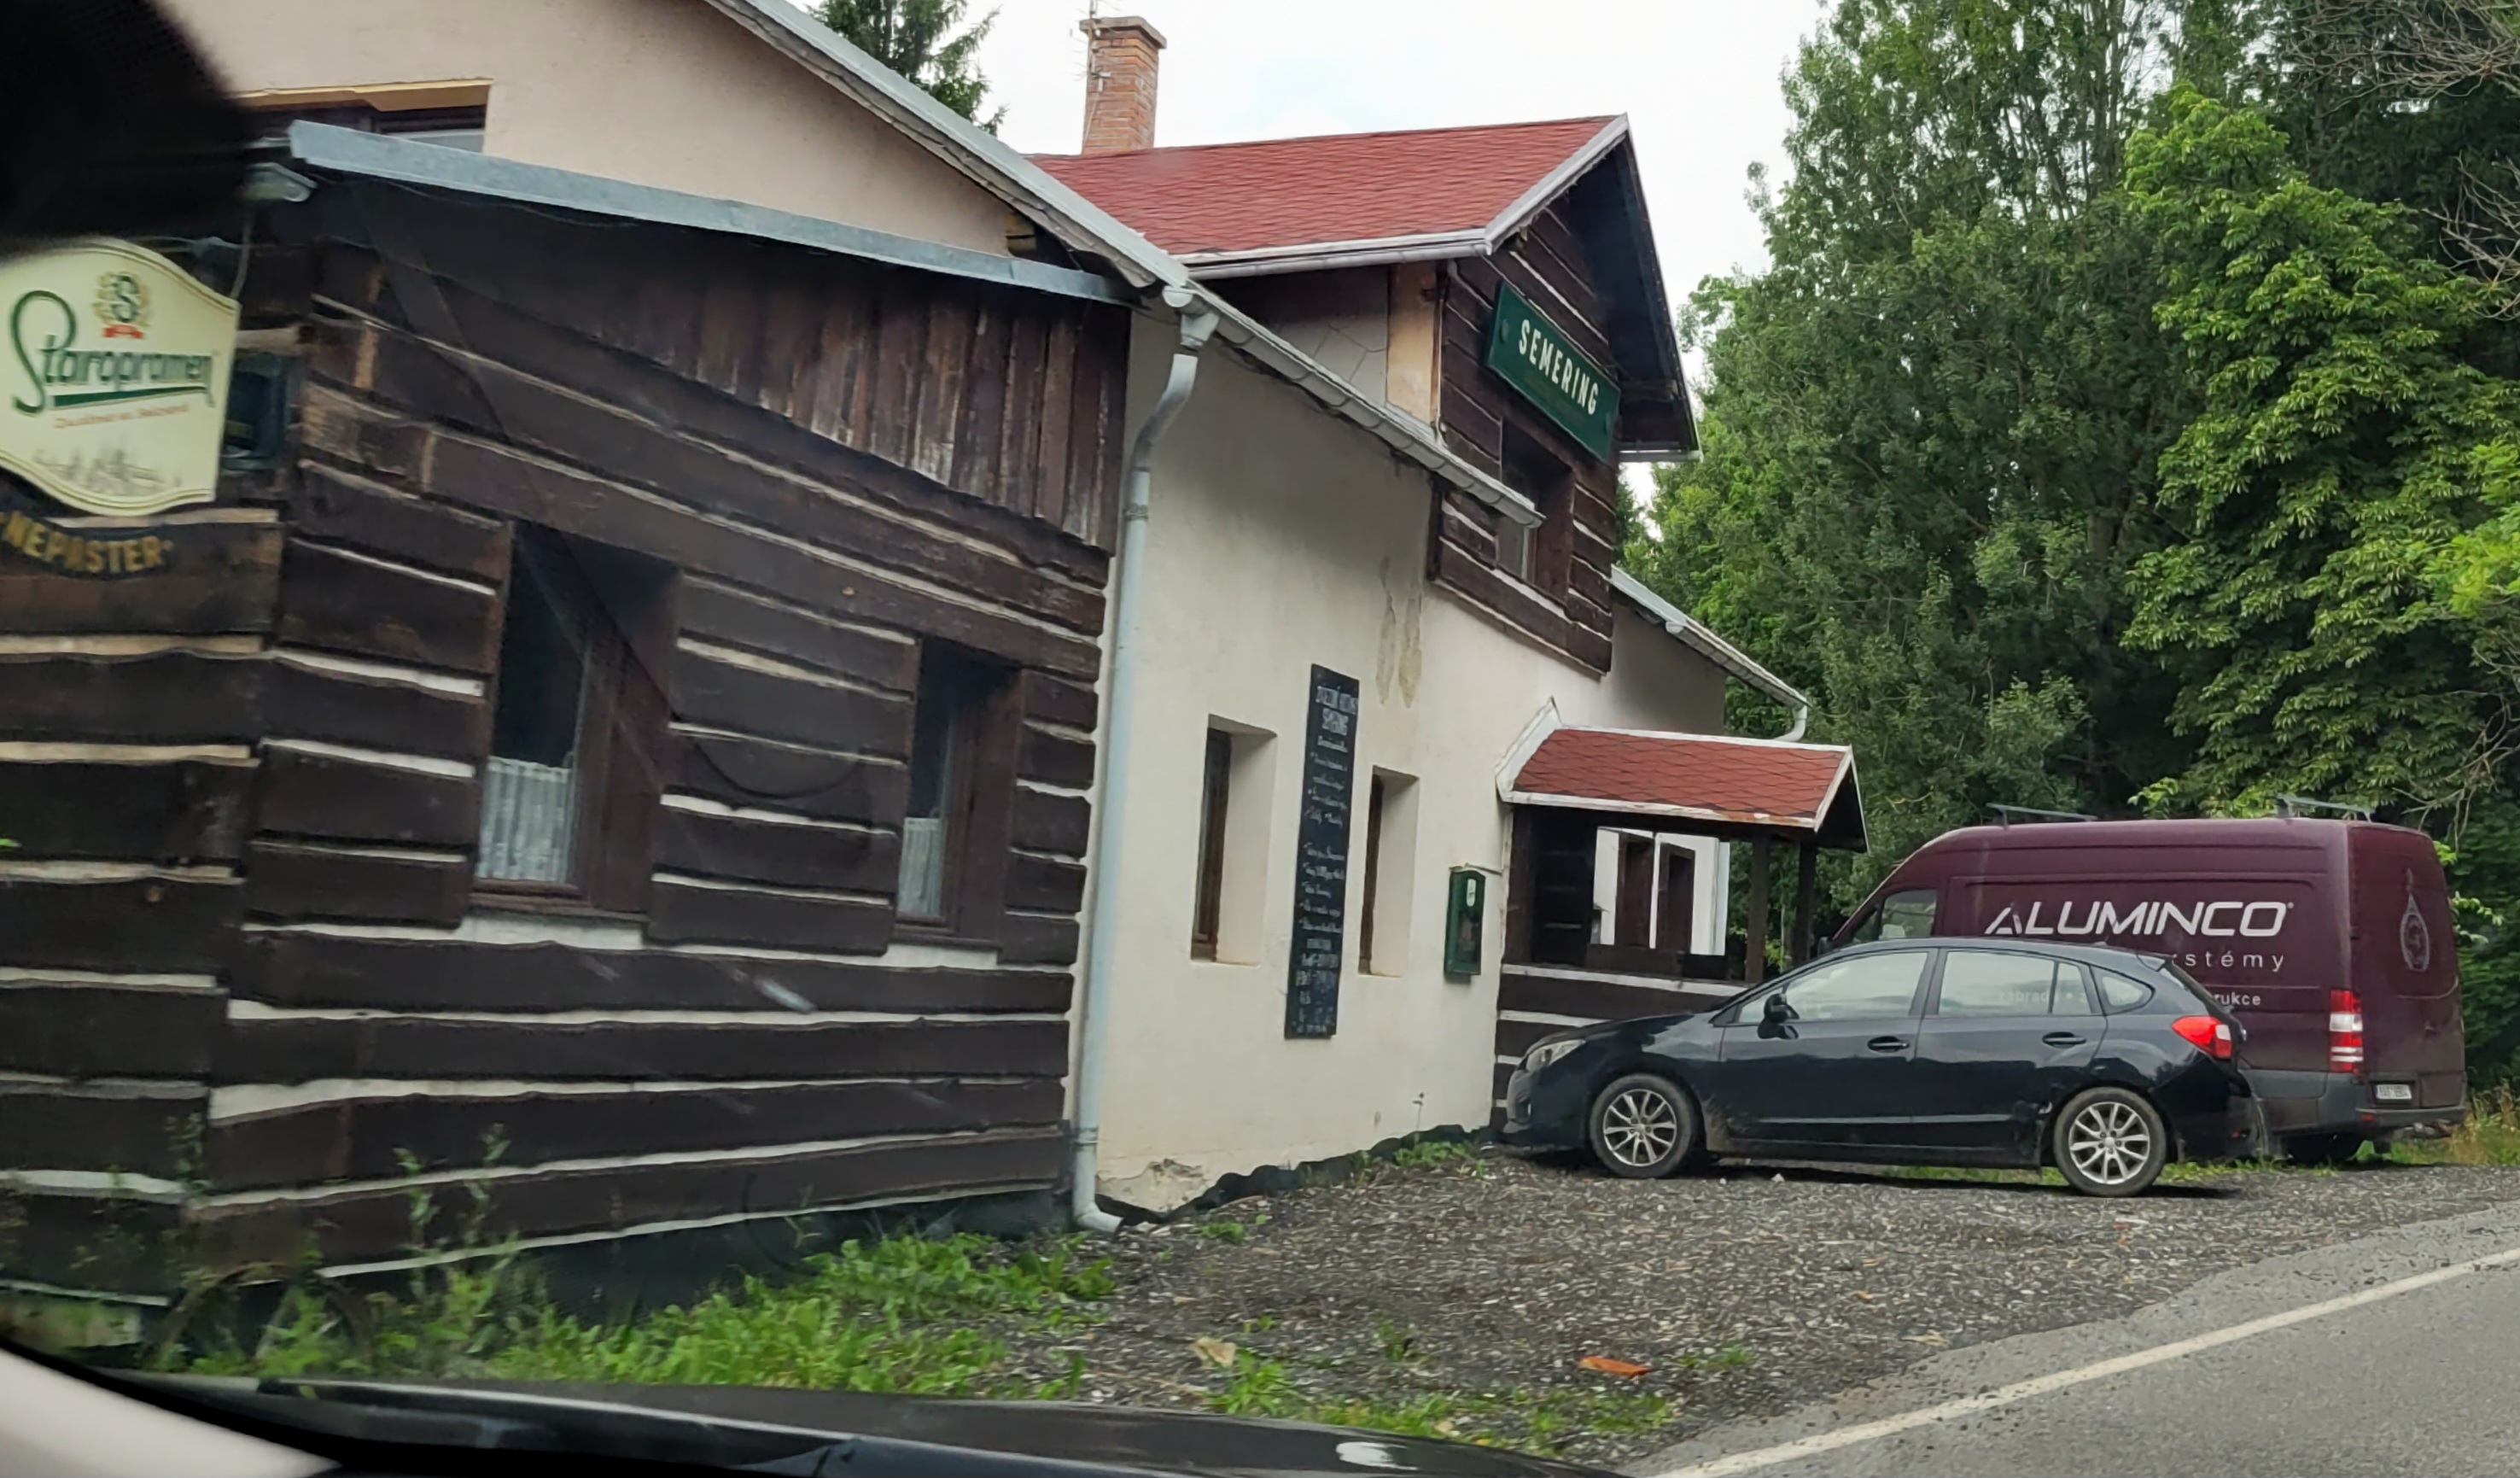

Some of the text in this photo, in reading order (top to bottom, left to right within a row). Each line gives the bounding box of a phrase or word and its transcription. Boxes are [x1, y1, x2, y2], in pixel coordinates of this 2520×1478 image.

[1519, 318, 1599, 415] SEMERING
[1984, 901, 2287, 937] ALUMINCO
[2172, 949, 2284, 973] stémy
[2214, 991, 2261, 1006] rukce
